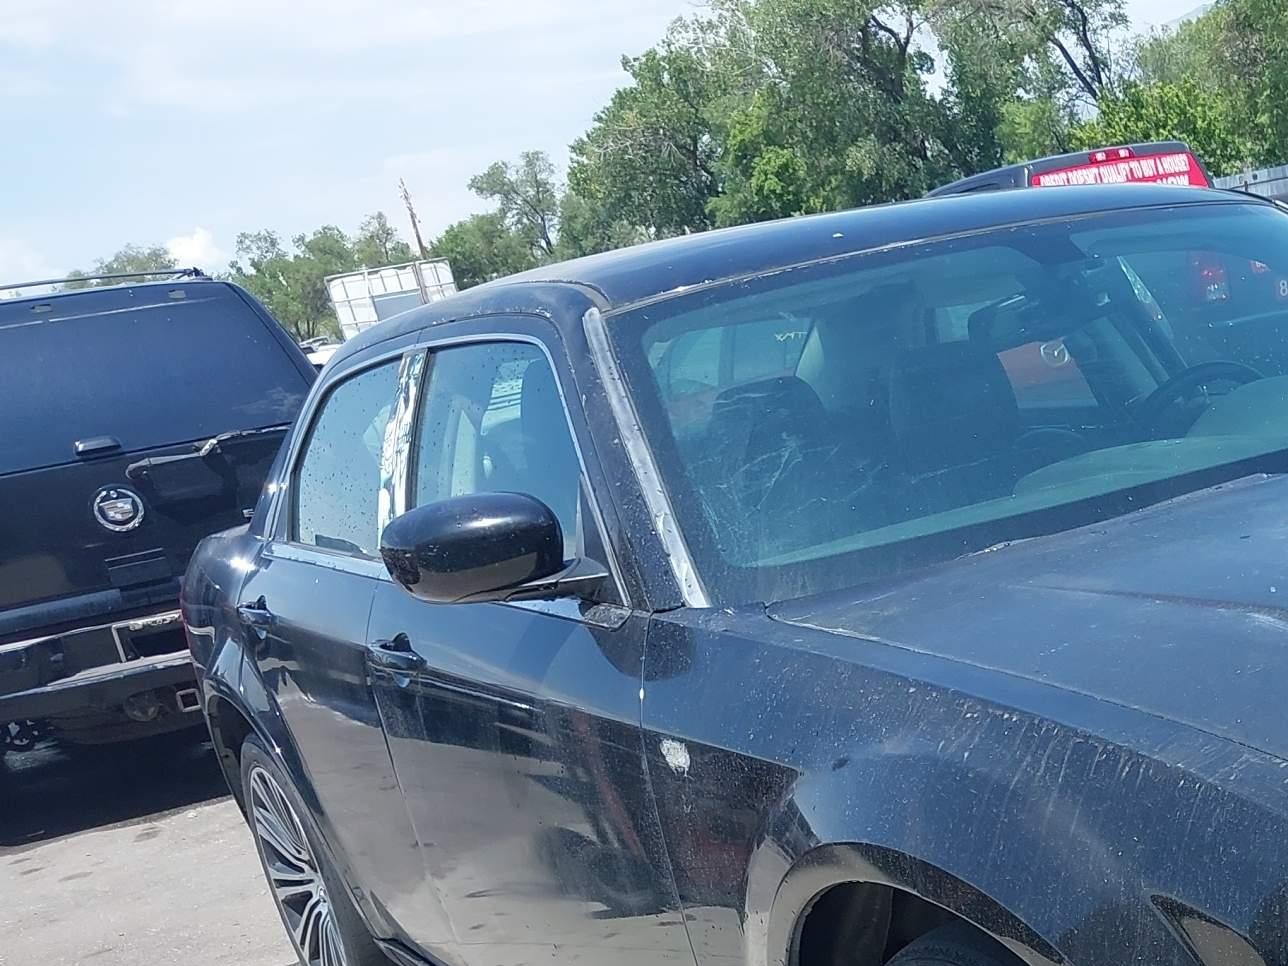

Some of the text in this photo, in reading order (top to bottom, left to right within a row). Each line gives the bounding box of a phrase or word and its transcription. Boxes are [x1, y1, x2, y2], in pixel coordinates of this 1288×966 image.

[1101, 163, 1132, 184] QUALIFY
[1130, 161, 1144, 179] TO
[1142, 158, 1157, 177] BUY
[1156, 157, 1164, 175] A
